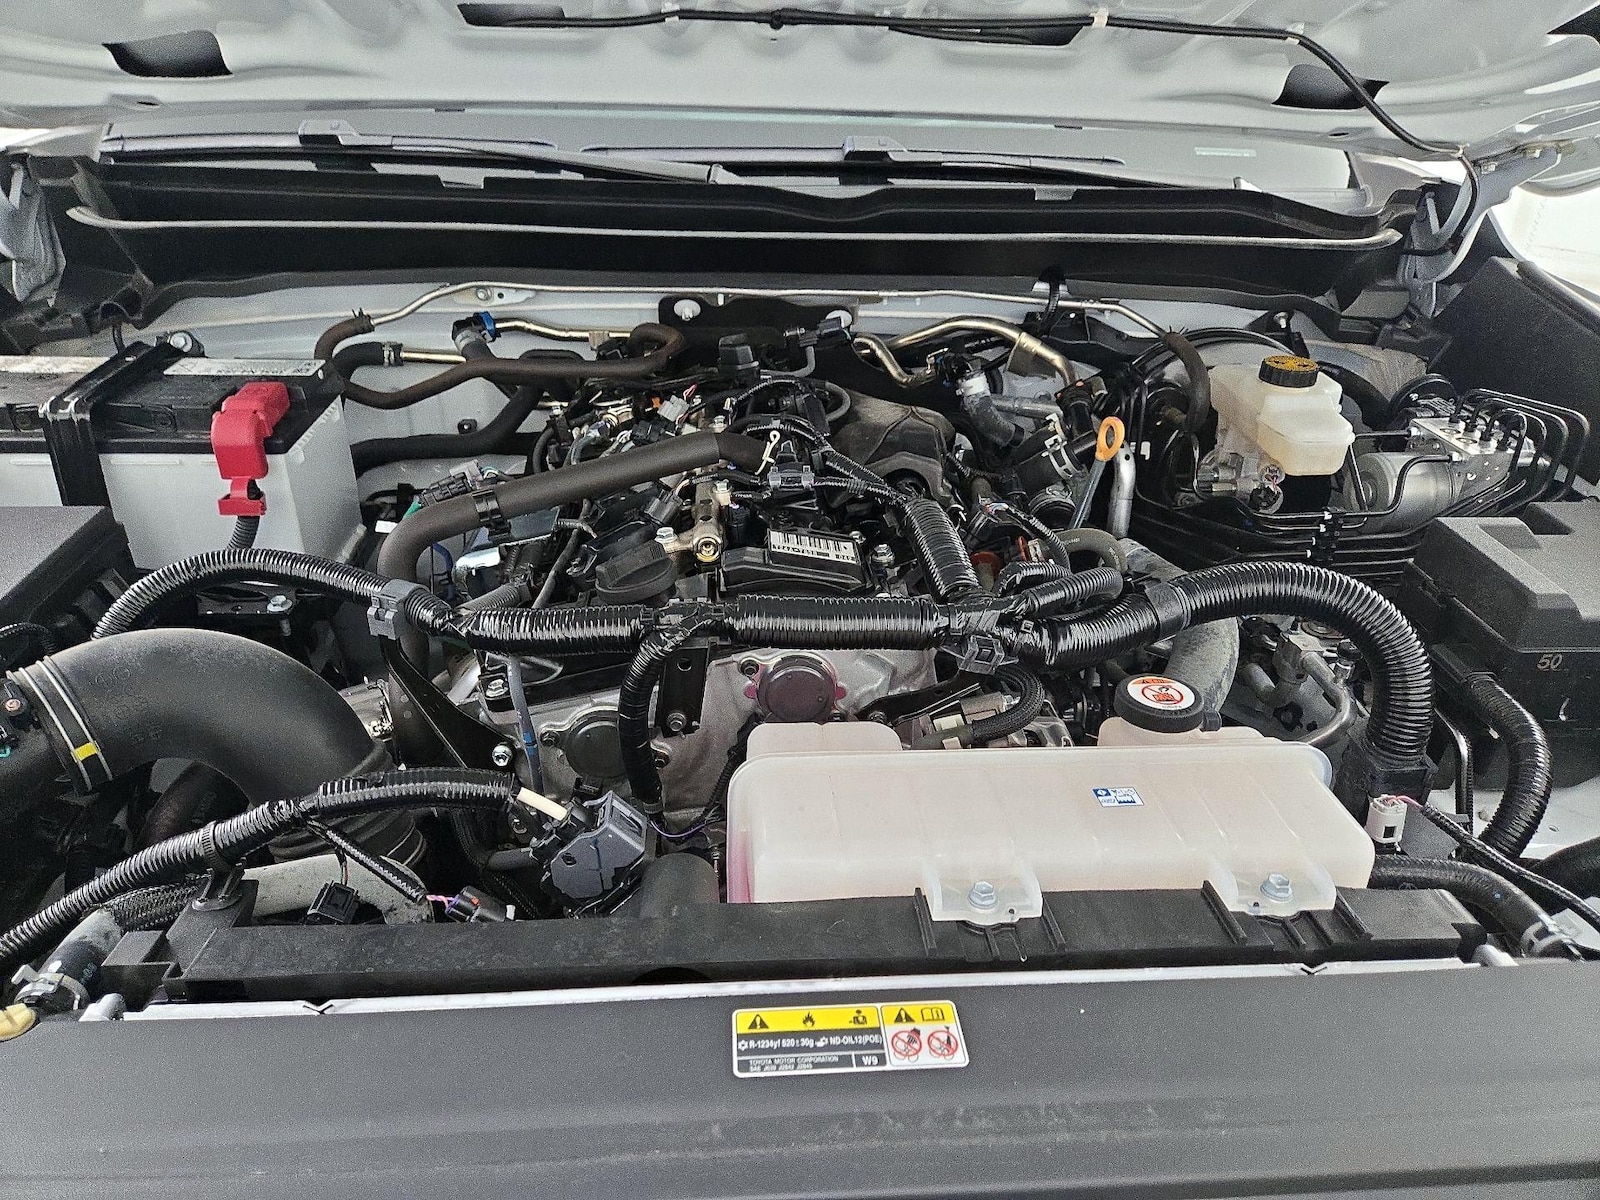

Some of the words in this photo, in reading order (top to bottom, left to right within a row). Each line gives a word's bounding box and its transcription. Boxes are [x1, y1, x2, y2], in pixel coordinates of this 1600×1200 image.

[1537, 653, 1562, 669] 50
[749, 1038, 781, 1050] R-1234yf
[861, 1055, 879, 1066] W9
